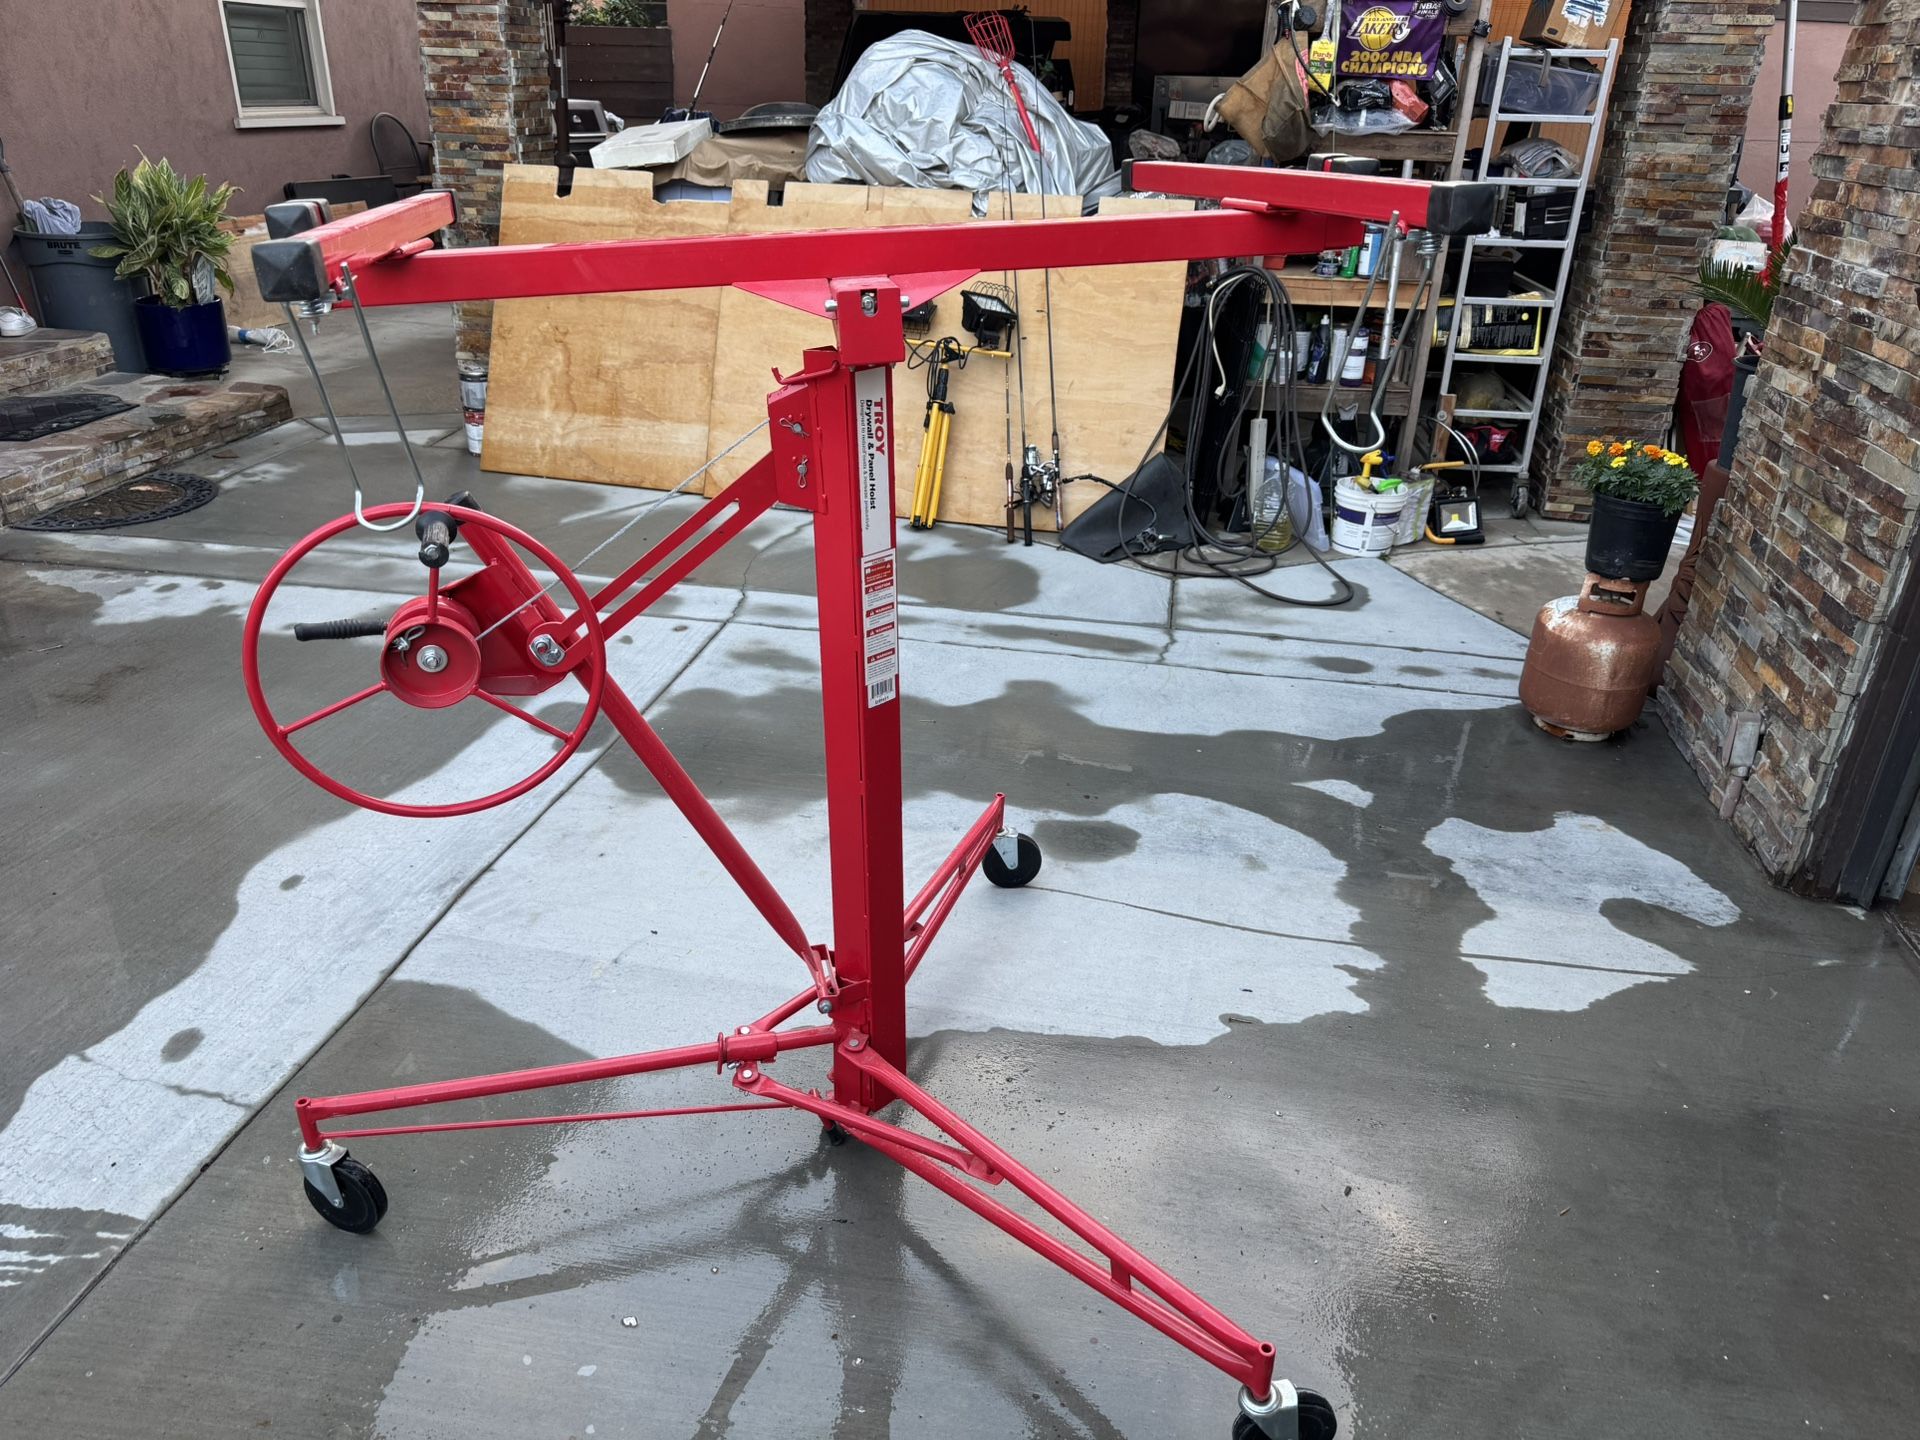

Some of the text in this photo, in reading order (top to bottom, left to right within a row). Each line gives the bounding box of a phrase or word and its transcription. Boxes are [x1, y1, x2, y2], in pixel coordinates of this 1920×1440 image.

[1419, 2, 1438, 10] NBA
[1349, 17, 1408, 41] LAKERS
[1312, 50, 1333, 60] Purdy
[1349, 50, 1423, 63] 2000 NBA
[1341, 60, 1428, 76] CHAMPIONS
[47, 241, 82, 249] BRUTE
[873, 397, 886, 456] TROY
[865, 399, 877, 510] Drywall & Panel Hoist
